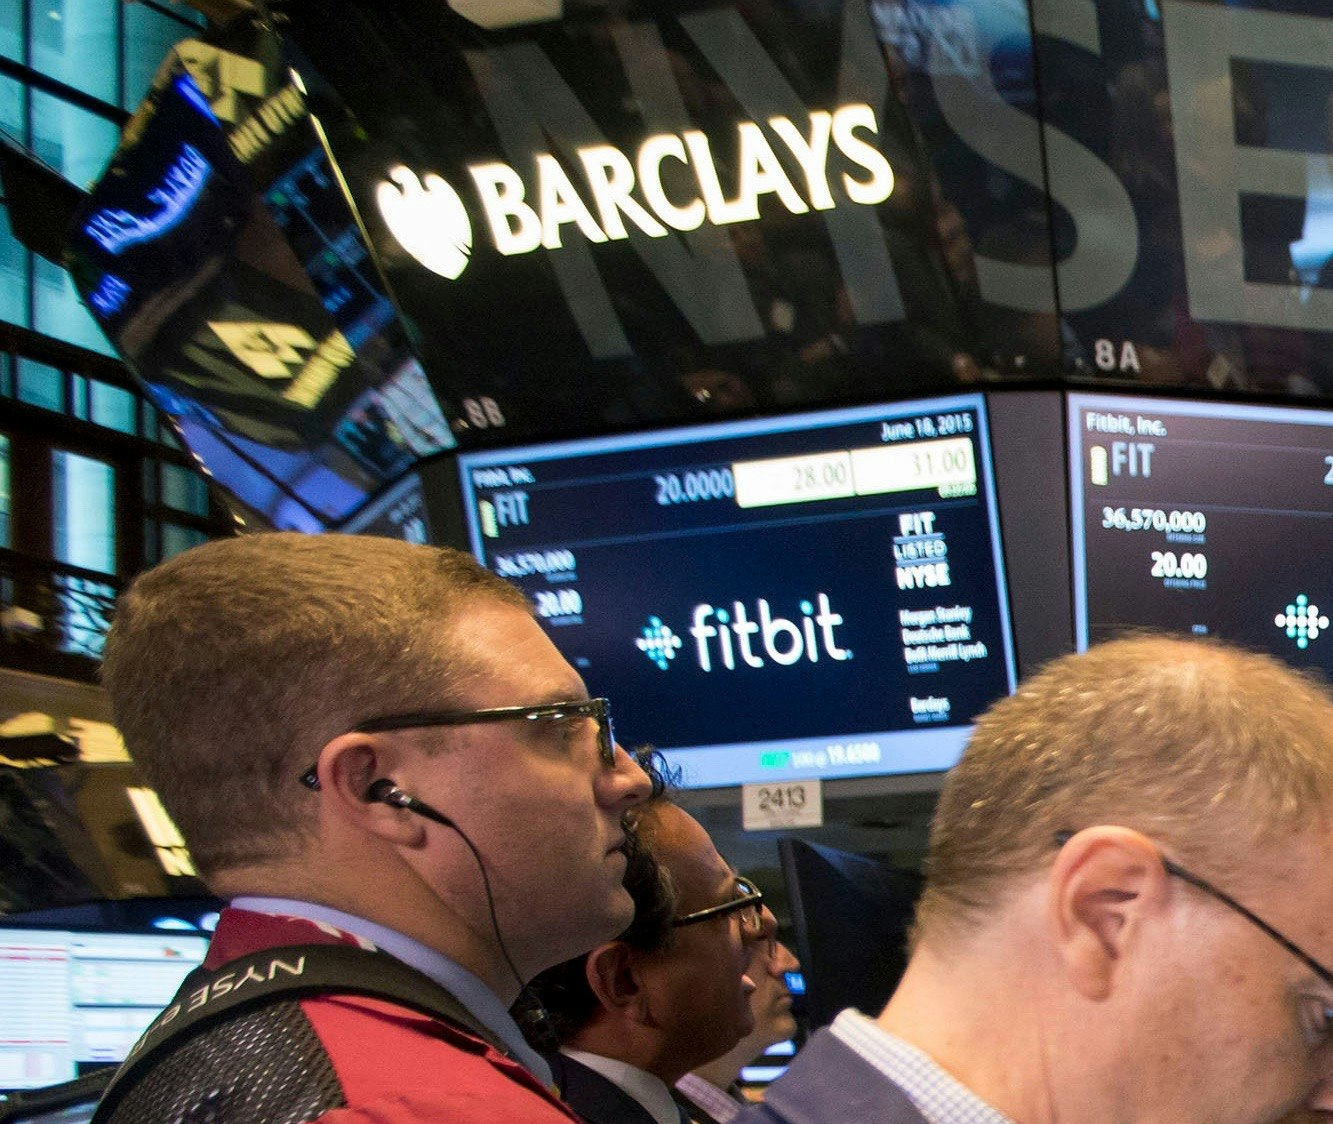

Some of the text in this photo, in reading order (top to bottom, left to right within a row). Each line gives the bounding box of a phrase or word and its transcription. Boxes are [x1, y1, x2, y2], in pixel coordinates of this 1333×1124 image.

[469, 104, 895, 257] BARCLAYS
[1095, 339, 1139, 373] 8A
[464, 396, 506, 429] 8B
[881, 421, 915, 442] June
[938, 412, 974, 436] 2015
[1086, 412, 1135, 436] Fitbit,
[1136, 416, 1167, 437] Inc.
[794, 448, 967, 491] 28.00 31.00
[1112, 441, 1155, 478] FIT
[655, 467, 734, 506] 20.0000
[899, 511, 936, 536] FIT
[1102, 506, 1206, 533] 36,570,000
[894, 539, 948, 560] LISTED
[1151, 551, 1208, 579] 20.00
[895, 563, 951, 590] NYSE
[690, 593, 850, 672] fitbit
[757, 785, 806, 811] 2413
[188, 957, 305, 1012] NYSE
